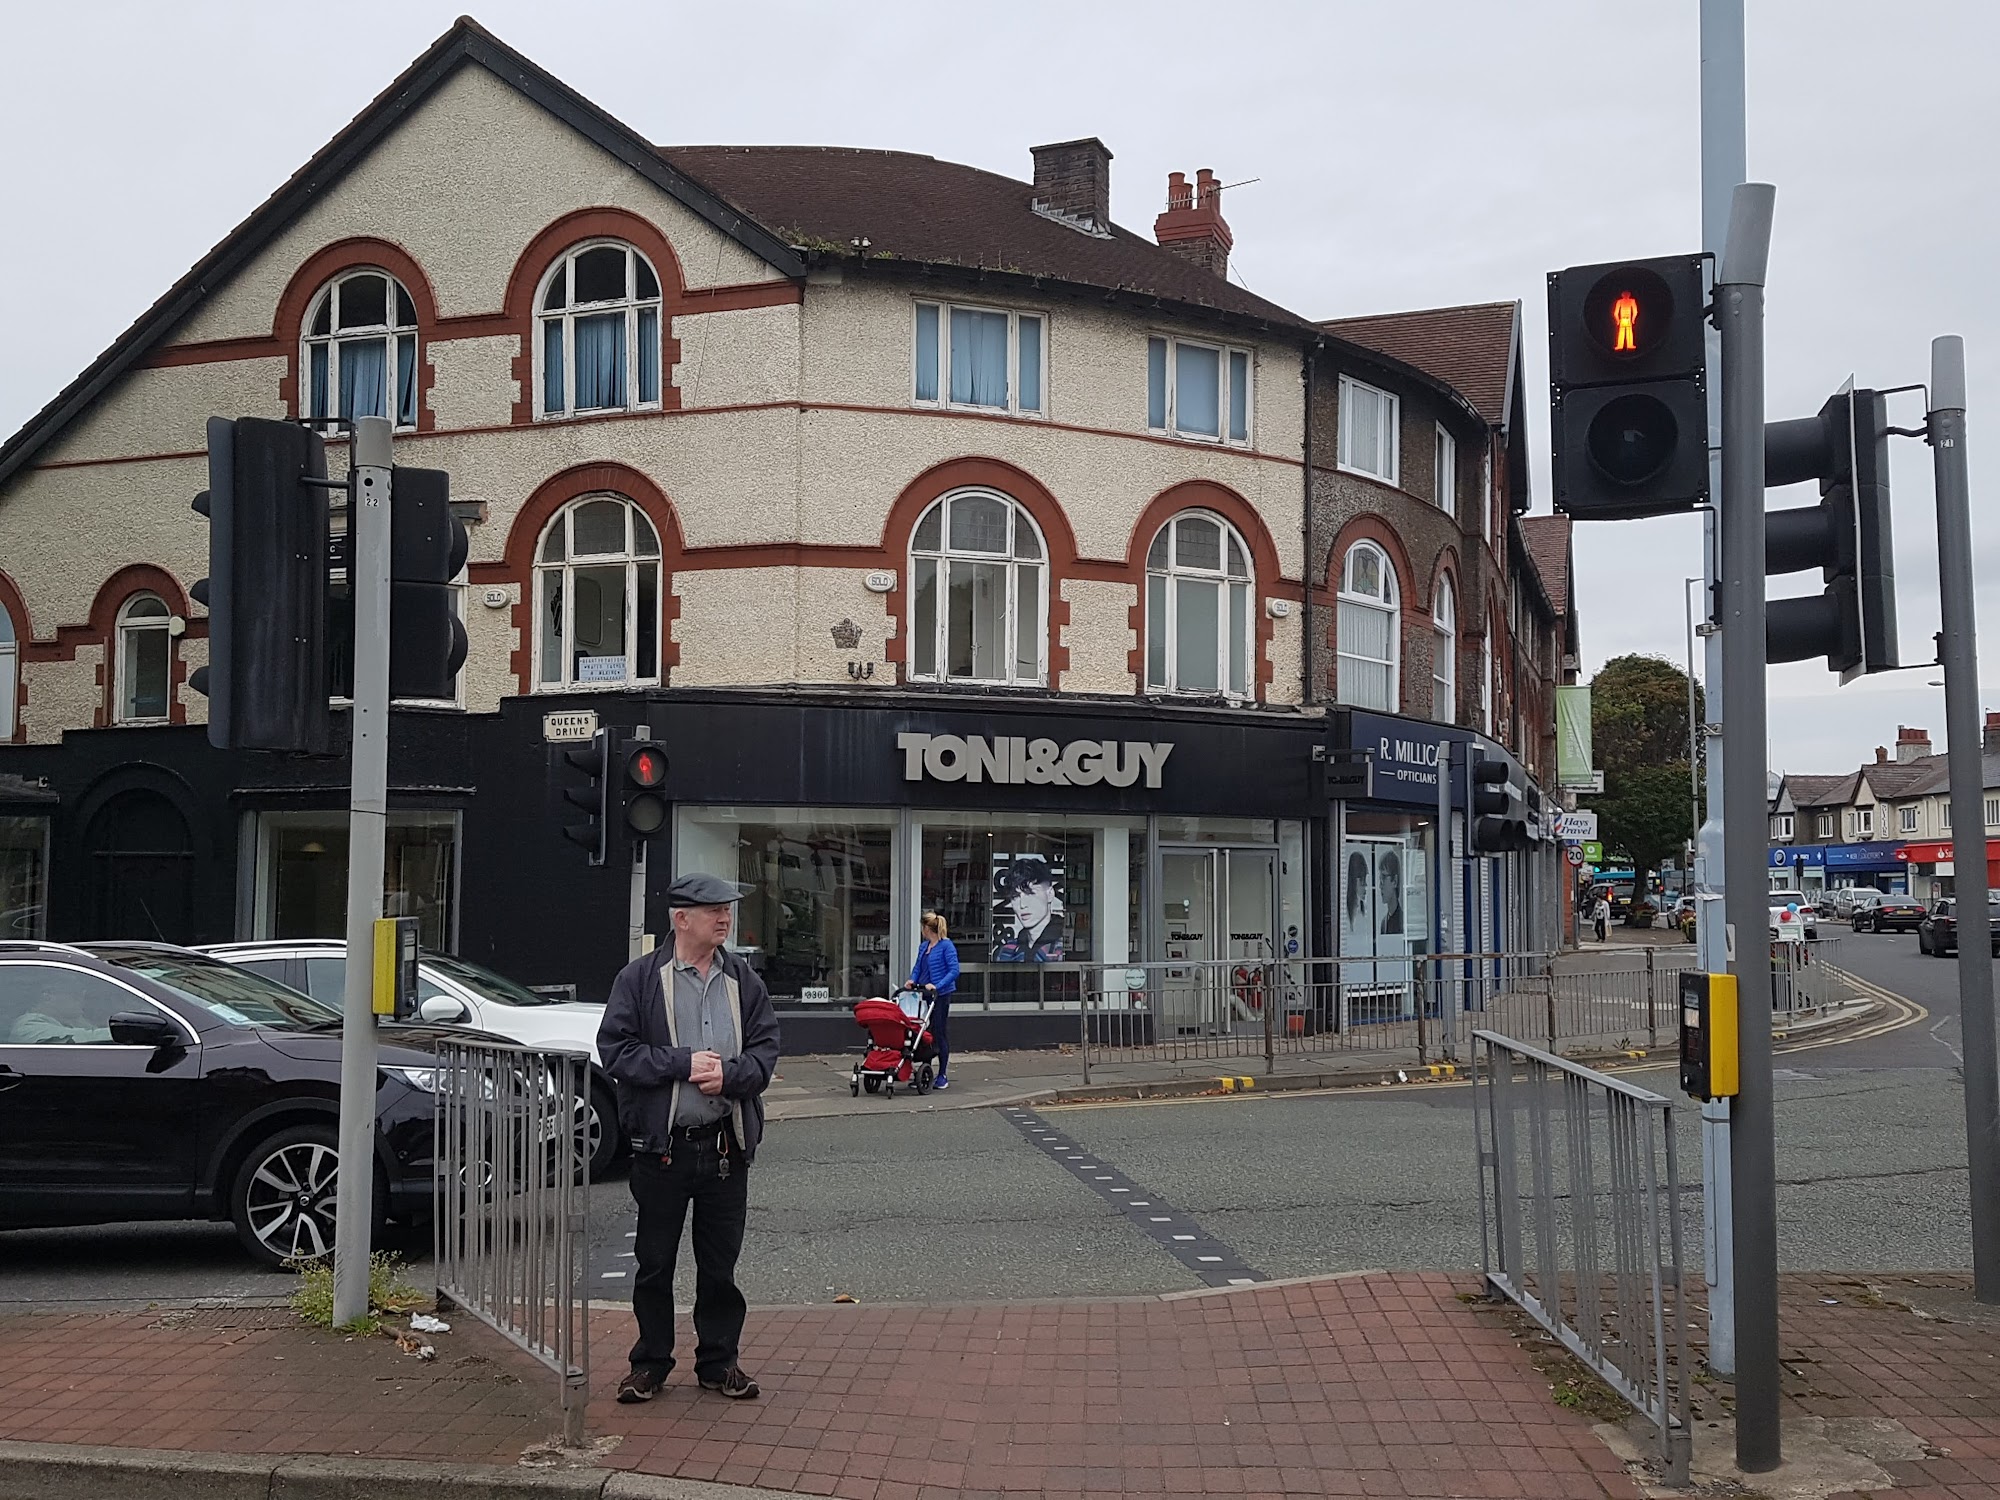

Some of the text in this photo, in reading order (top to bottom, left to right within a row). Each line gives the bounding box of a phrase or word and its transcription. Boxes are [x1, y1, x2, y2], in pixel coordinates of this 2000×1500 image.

[366, 498, 378, 507] 22
[551, 717, 589, 726] QUEENS
[556, 727, 585, 736] DRIVE
[1380, 737, 1392, 760] R.
[898, 732, 1175, 788] TONI&GUY
[1397, 769, 1437, 785] OPTICIANS
[1564, 817, 1589, 827] Hays
[1561, 826, 1592, 835] Travel
[1569, 851, 1582, 861] 20
[1171, 932, 1204, 941] TONI&GUY
[1230, 932, 1264, 941] TONI&GUY
